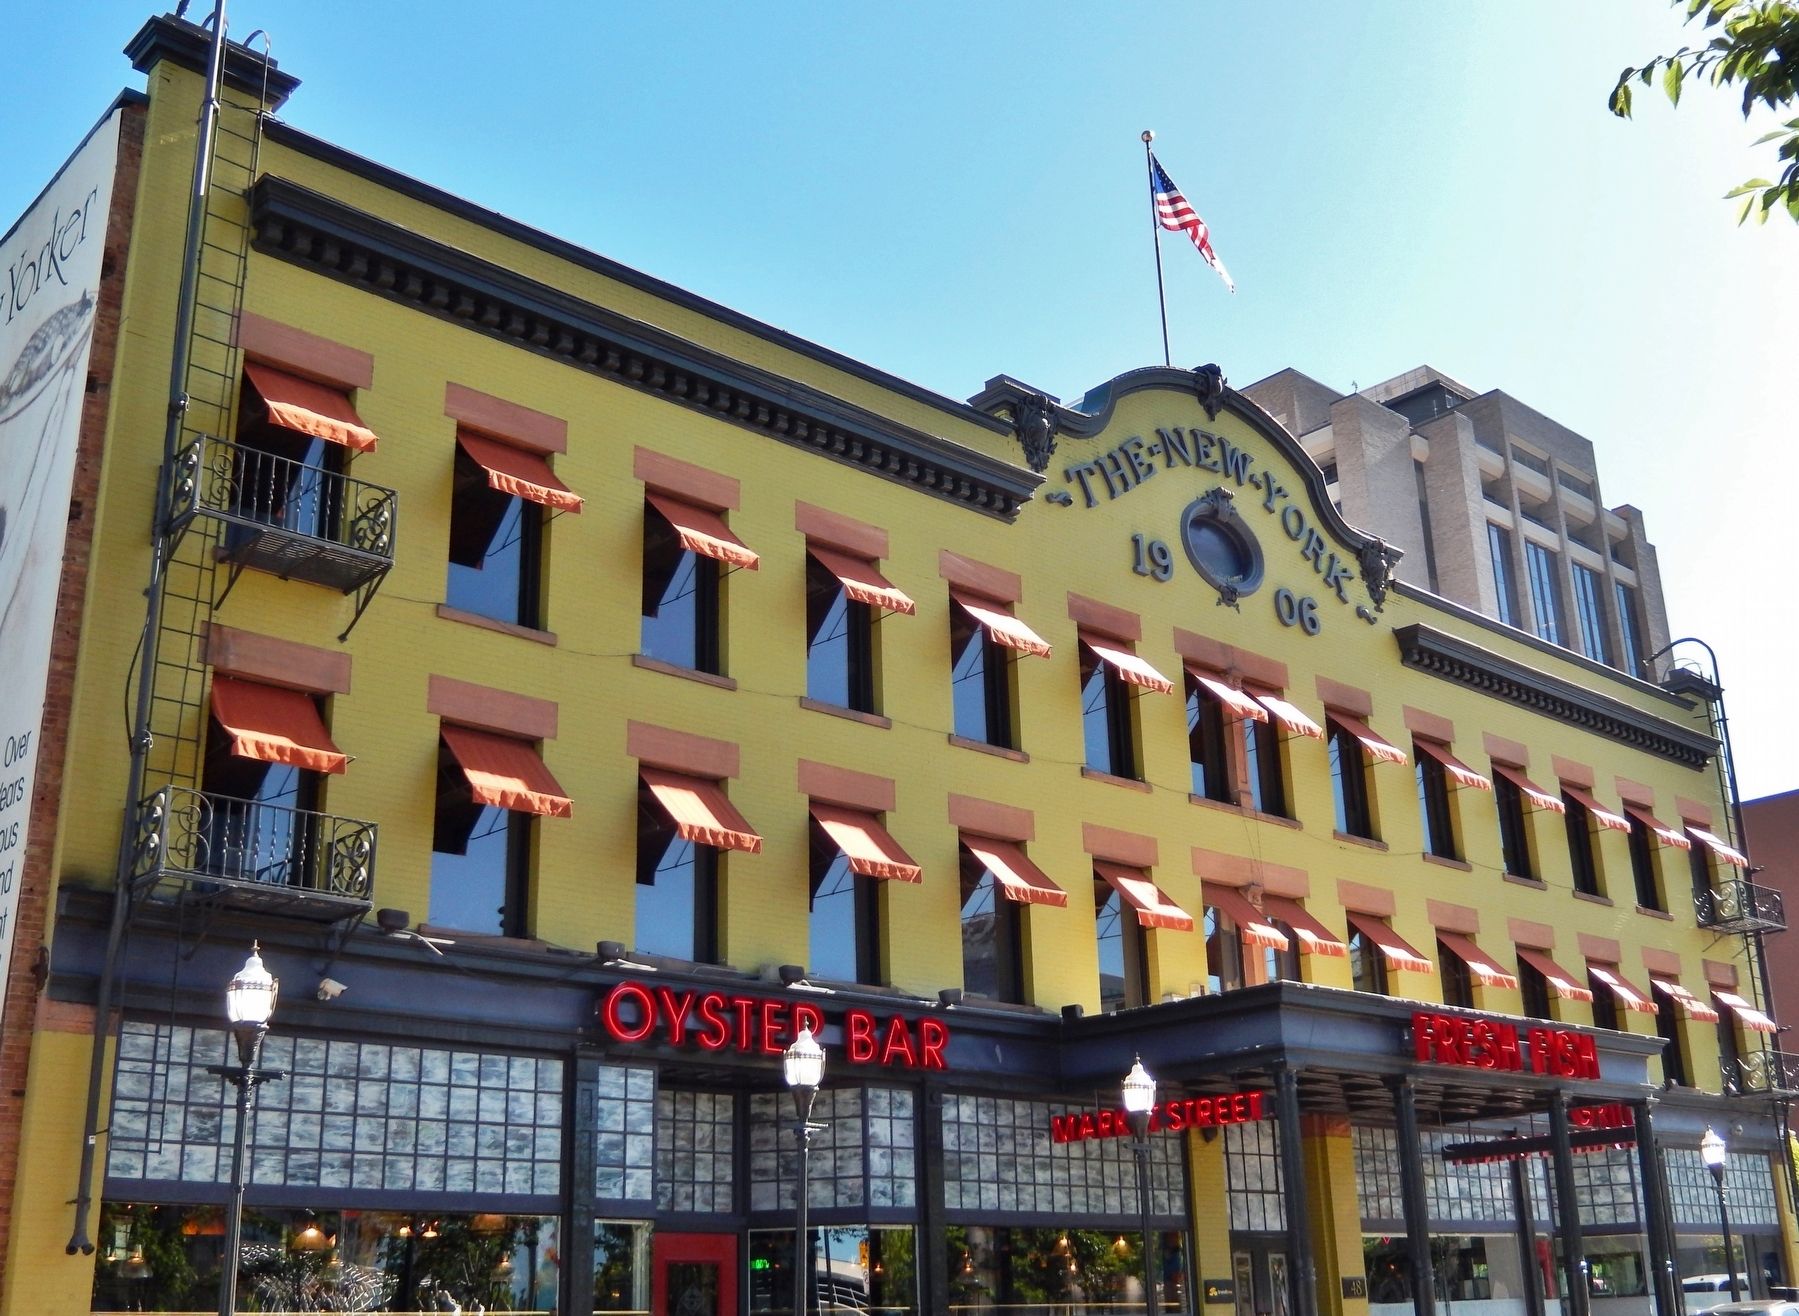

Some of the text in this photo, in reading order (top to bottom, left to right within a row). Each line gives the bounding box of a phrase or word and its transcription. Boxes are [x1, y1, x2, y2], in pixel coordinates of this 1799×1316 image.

[6, 184, 98, 326] Yorker
[1064, 427, 1354, 605] THE NEW YORK
[1131, 533, 1321, 636] 19 06
[5, 730, 32, 769] Over
[846, 1008, 948, 1071] BAR
[1412, 1011, 1600, 1080] FRESH FISH
[1051, 1090, 1265, 1143] MARKT STREET
